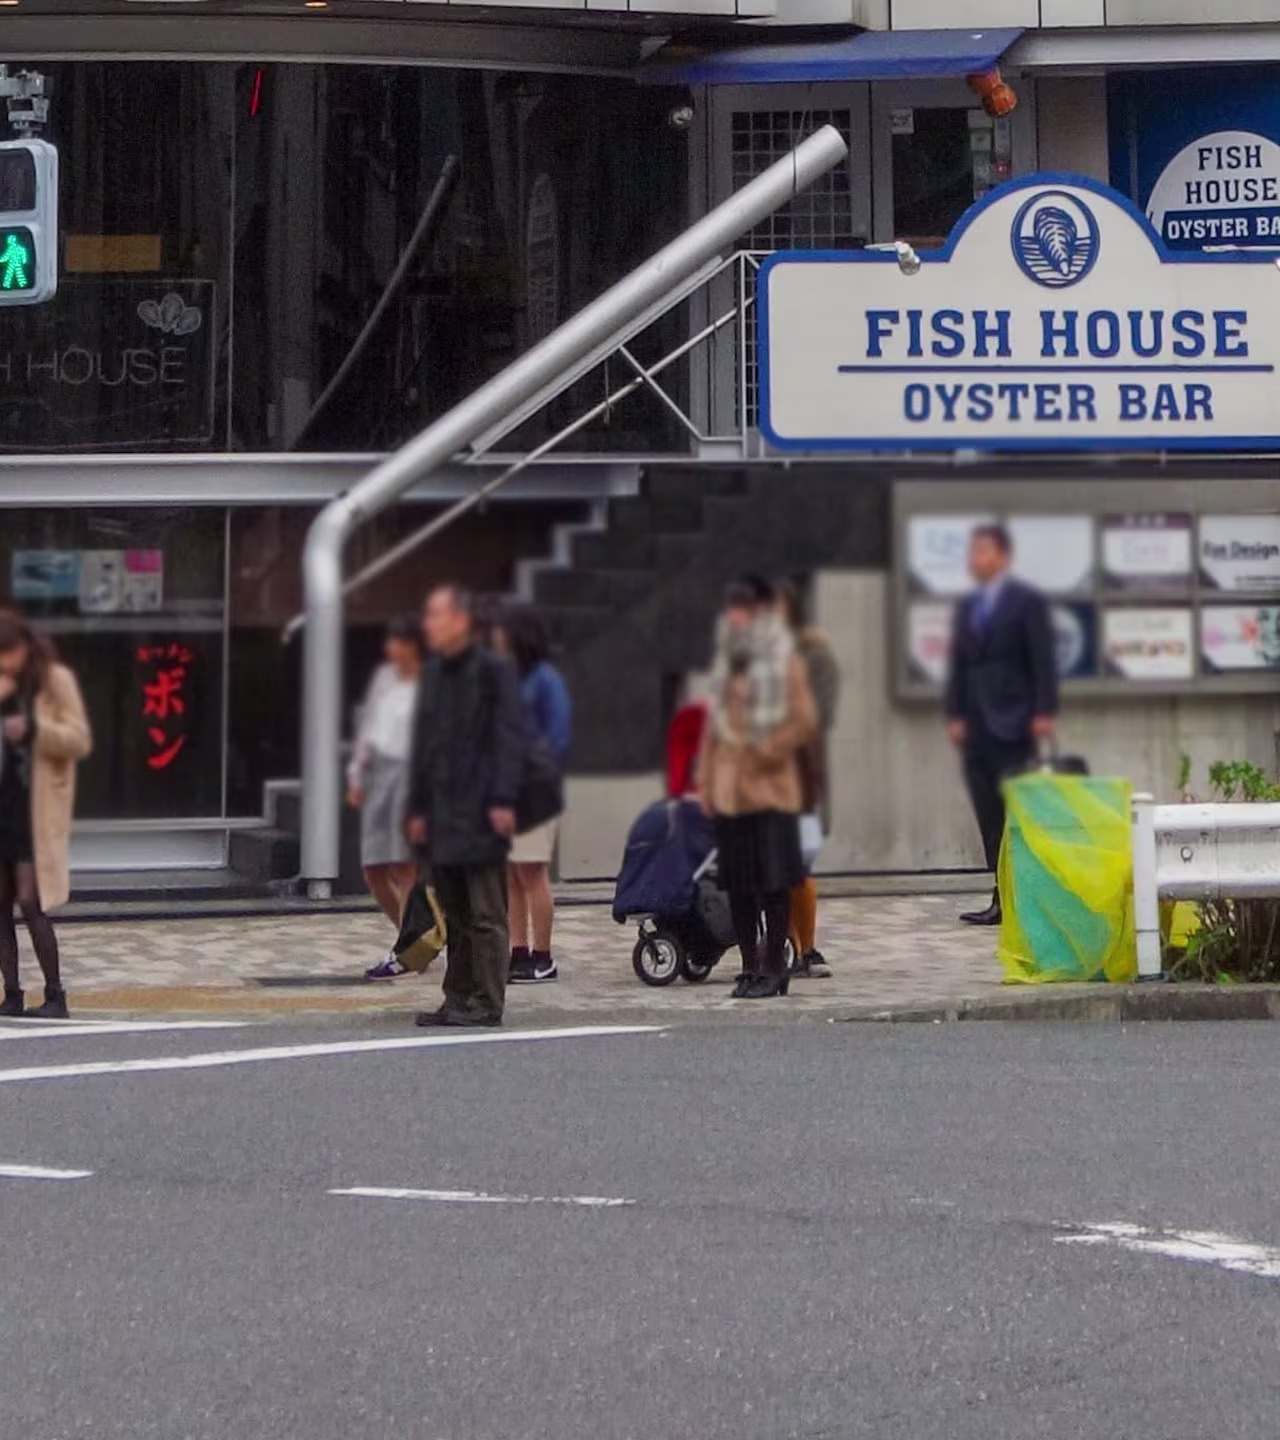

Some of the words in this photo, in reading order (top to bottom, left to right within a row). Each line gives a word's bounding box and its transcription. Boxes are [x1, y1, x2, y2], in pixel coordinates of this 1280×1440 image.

[1197, 144, 1263, 171] FISH
[1184, 177, 1279, 205] HOUSE
[1166, 216, 1249, 240] OYSTER
[864, 309, 1012, 359] FISH
[1039, 309, 1250, 359] HOUSE
[27, 344, 188, 386] HOUSE
[903, 382, 1098, 423] OYSTER
[1118, 382, 1214, 422] BAR
